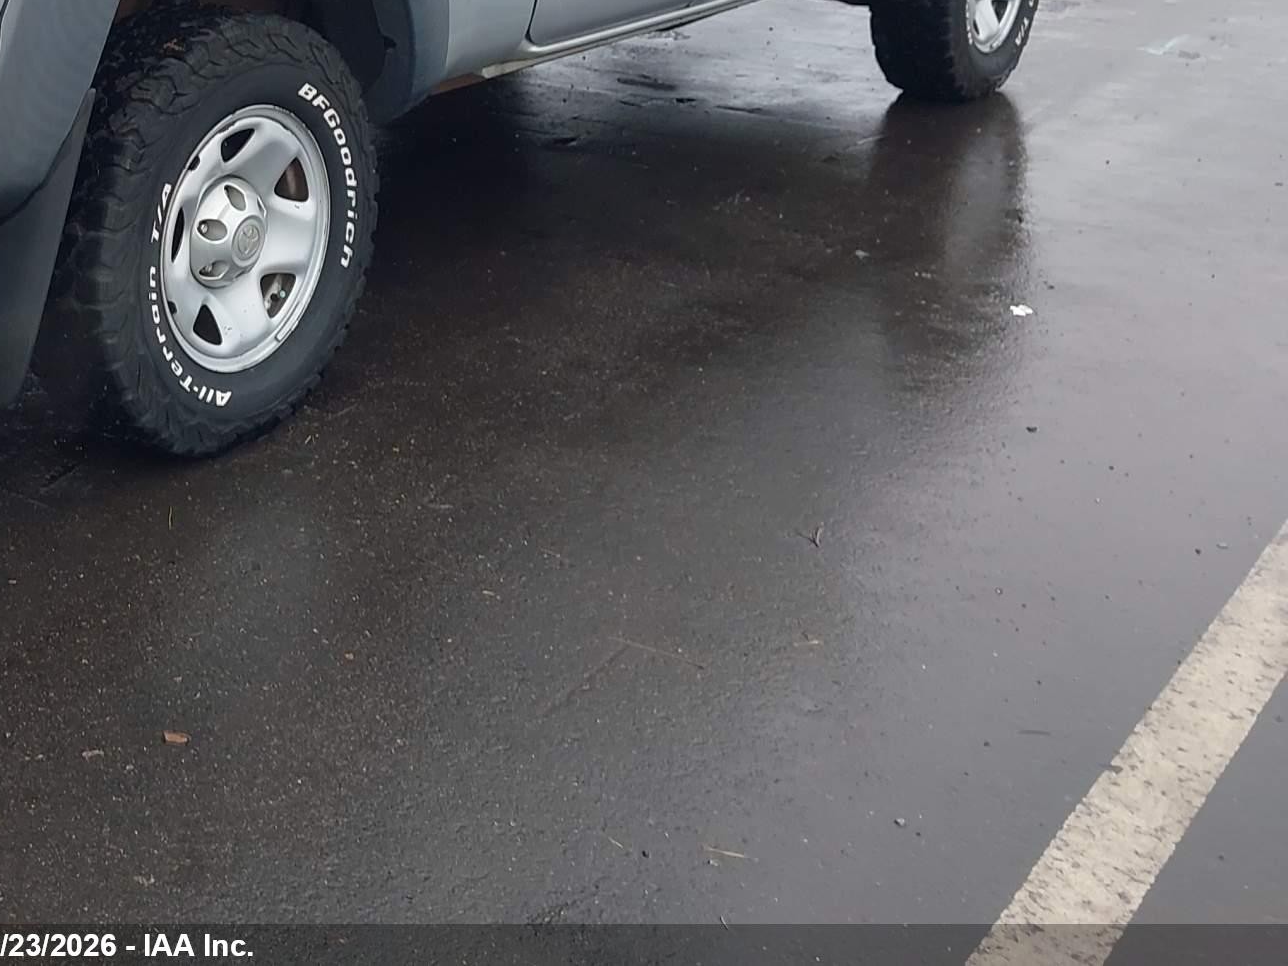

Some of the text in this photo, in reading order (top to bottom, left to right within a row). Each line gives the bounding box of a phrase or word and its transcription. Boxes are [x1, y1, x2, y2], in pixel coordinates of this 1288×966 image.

[298, 82, 358, 268] BFGoodrich
[148, 183, 232, 407] All-Terrain T/A
